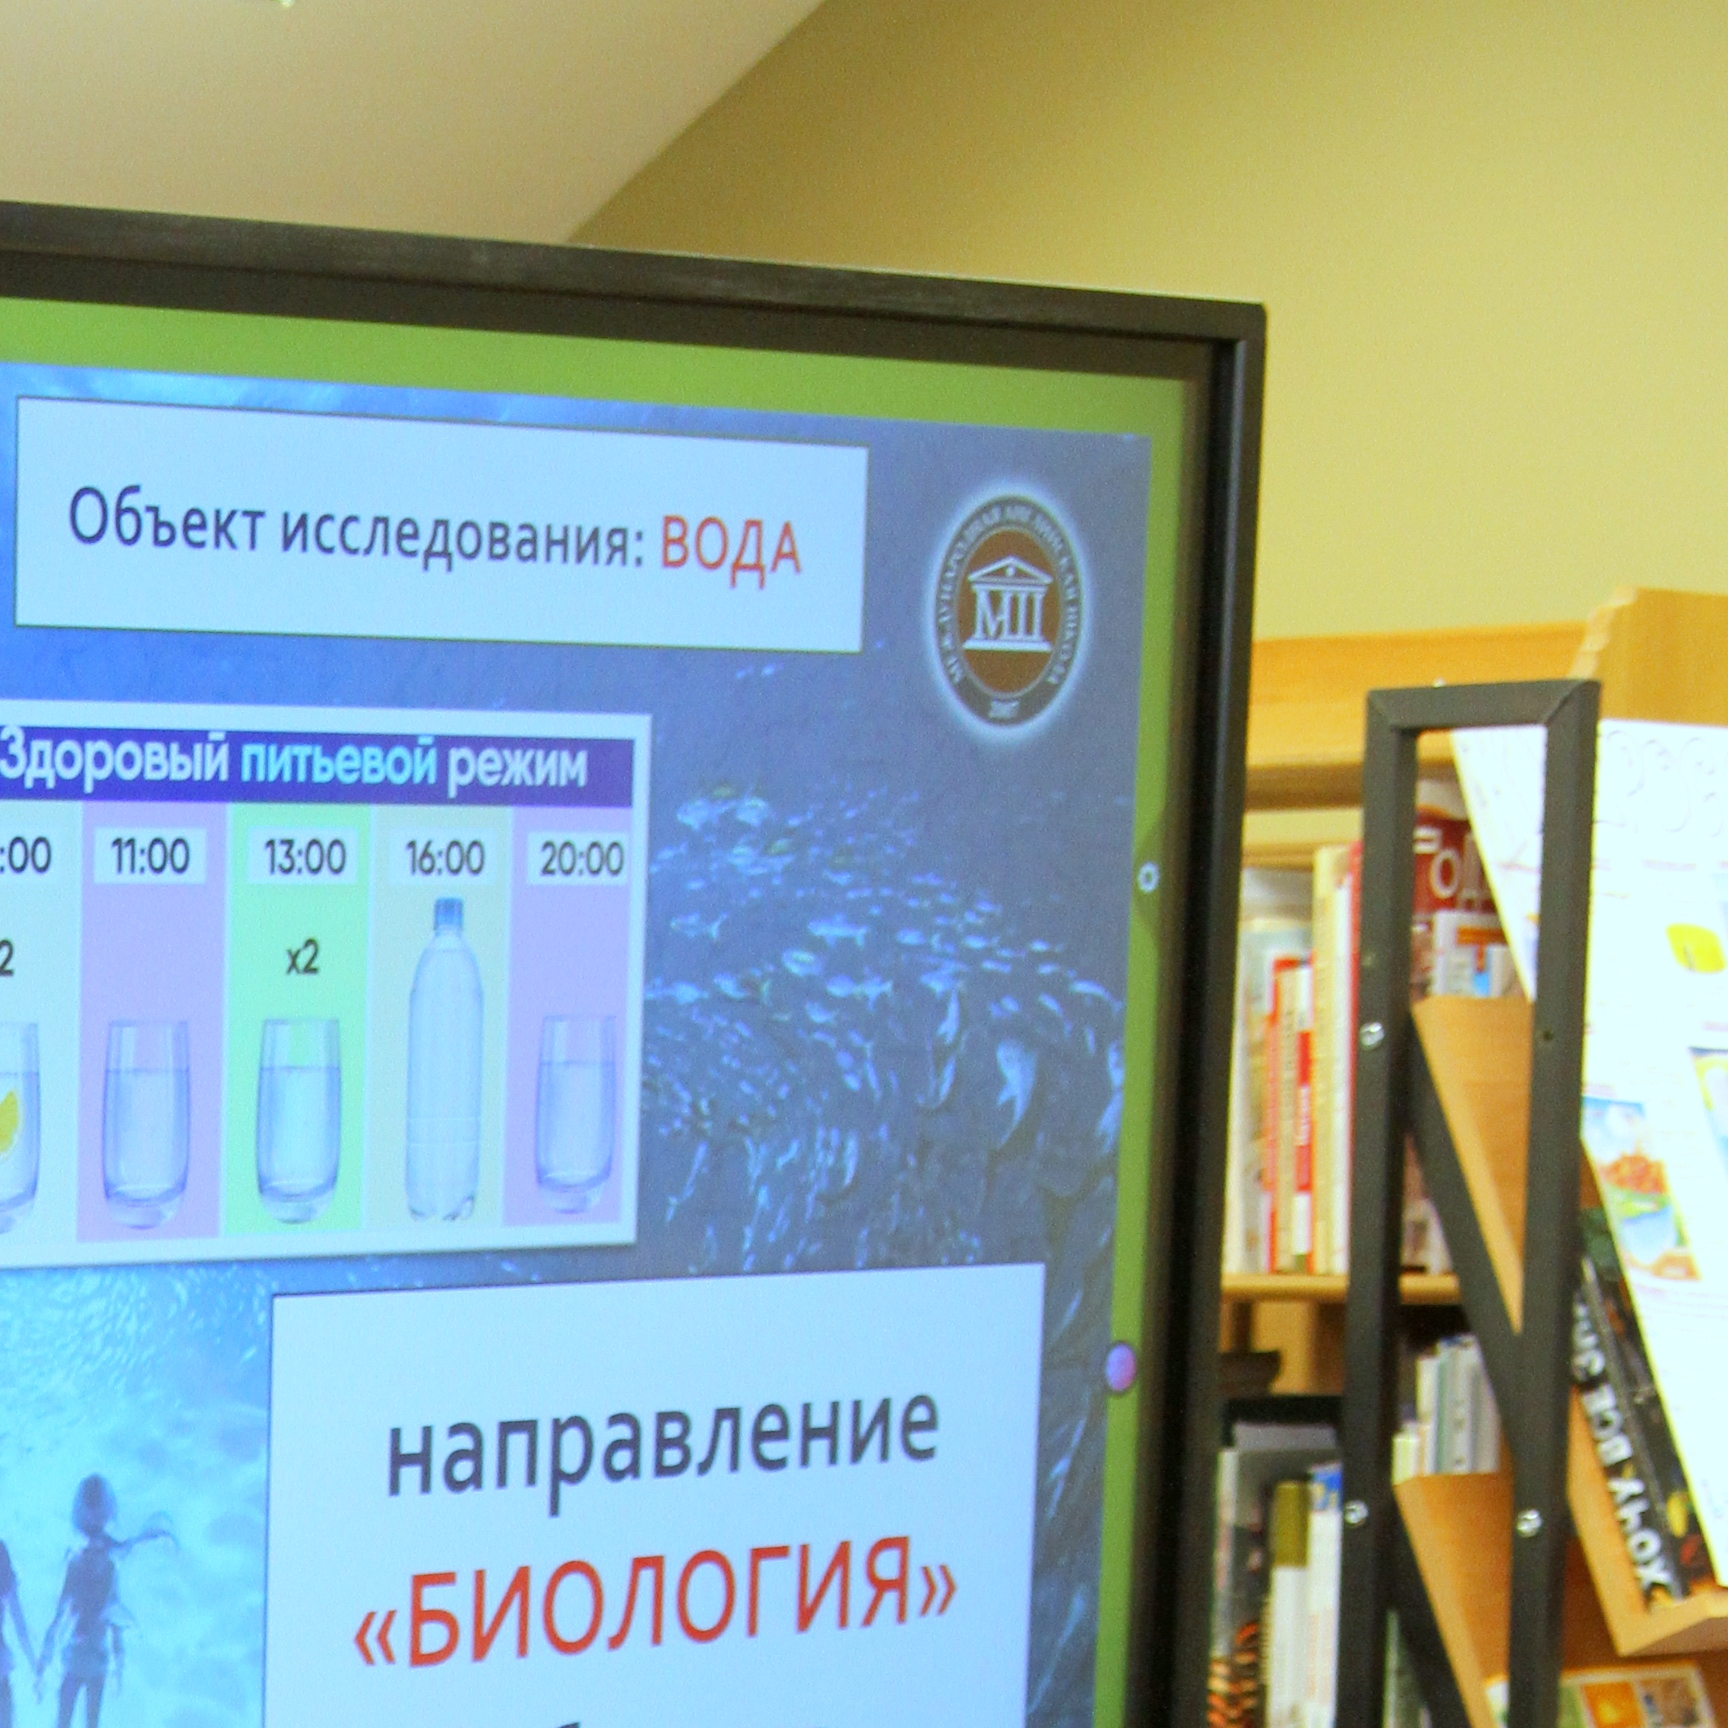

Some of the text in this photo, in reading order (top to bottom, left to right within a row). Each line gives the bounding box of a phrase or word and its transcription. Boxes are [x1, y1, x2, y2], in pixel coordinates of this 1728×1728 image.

[69, 485, 801, 589] Объект исследования: ВОДА
[241, 734, 437, 788] питьевой
[447, 744, 588, 798] режим
[110, 837, 191, 877] 11:00
[264, 838, 347, 878] 13:00
[405, 839, 486, 879] 16:00
[539, 840, 625, 879] 20:00
[387, 1391, 940, 1518] направление
[354, 1534, 958, 1668] «БИОЛОГИЯ»
